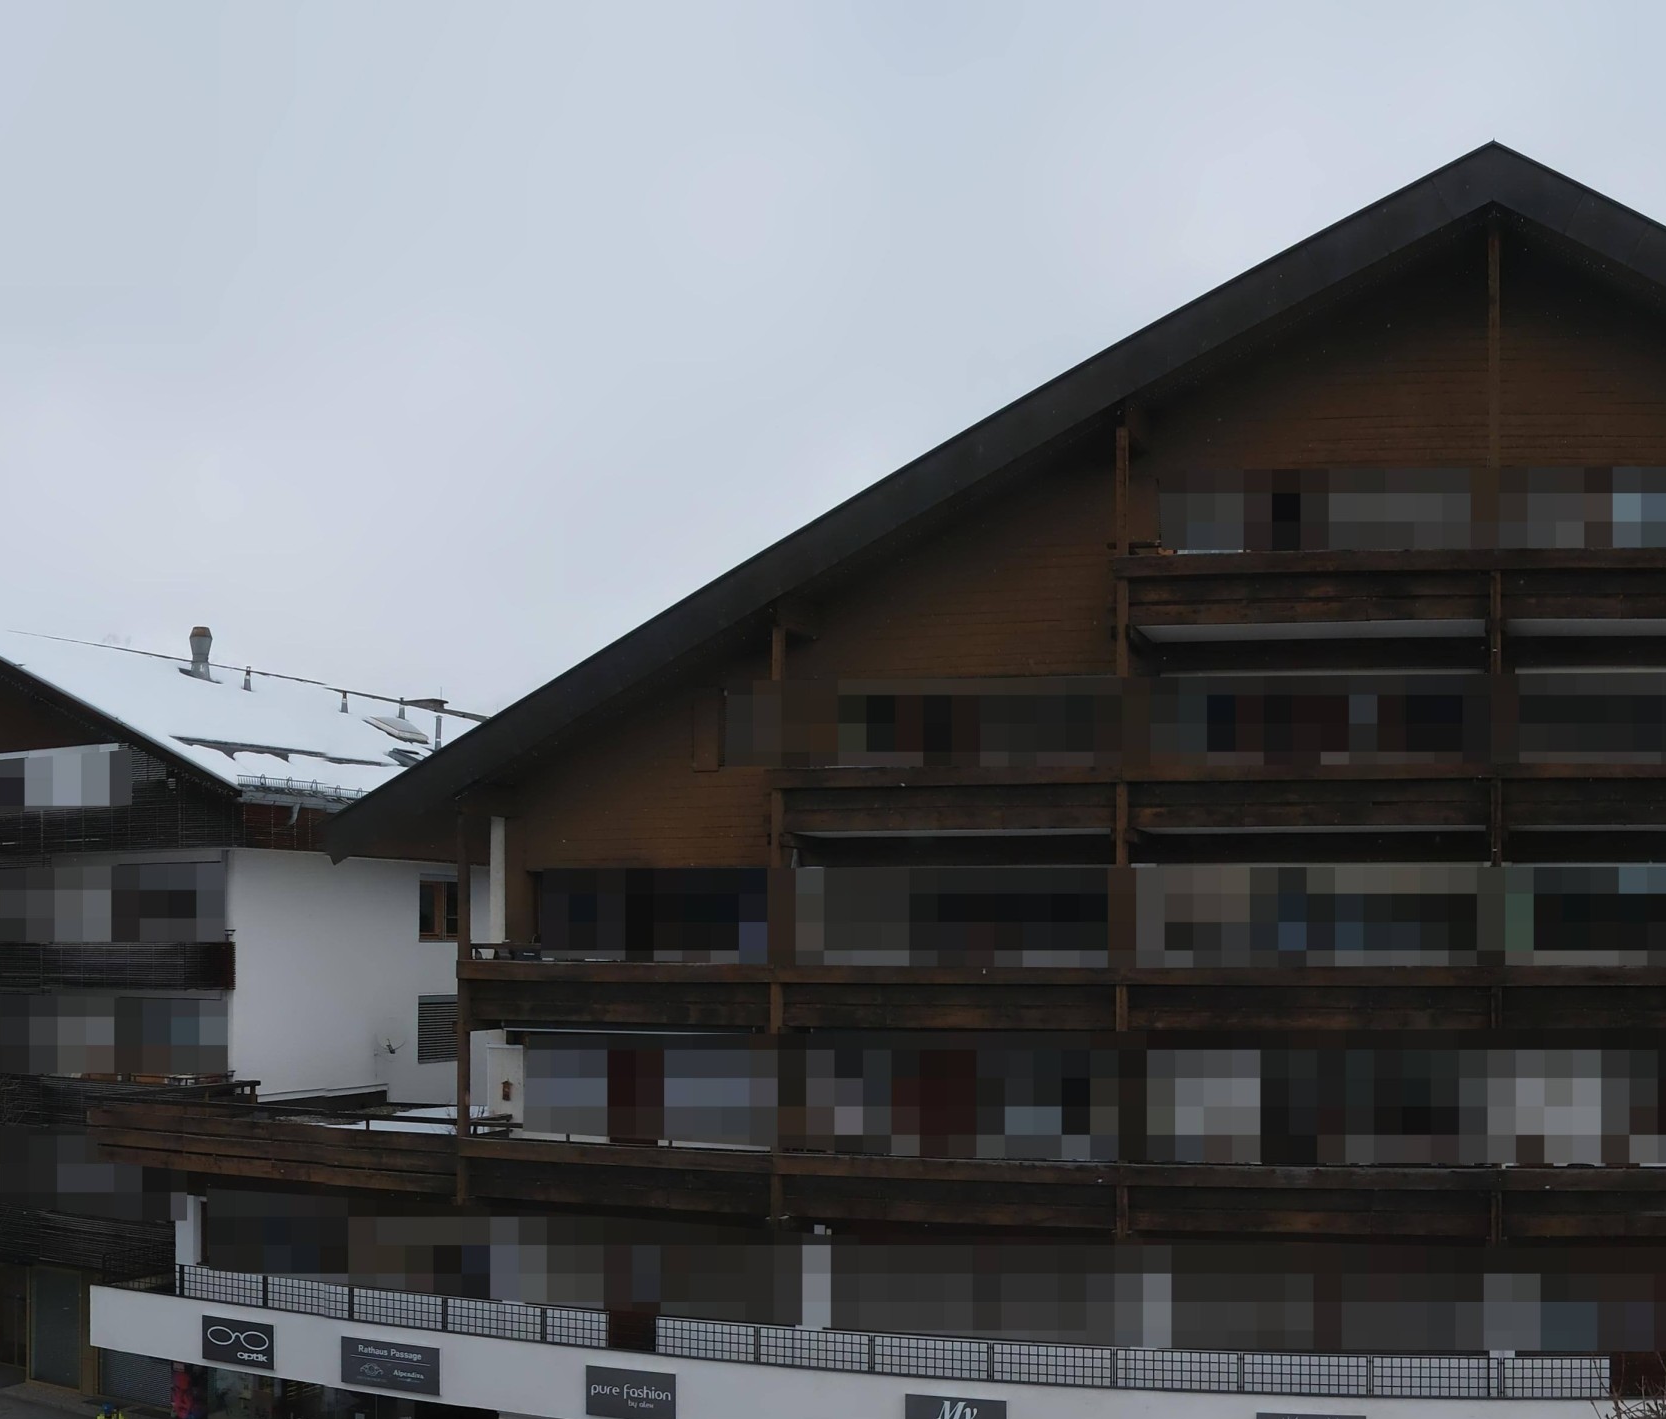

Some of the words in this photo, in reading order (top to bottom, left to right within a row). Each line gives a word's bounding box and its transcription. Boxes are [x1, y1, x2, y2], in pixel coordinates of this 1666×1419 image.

[236, 1351, 269, 1363] optik
[358, 1344, 388, 1356] Rathaus
[390, 1348, 422, 1362] Passage
[591, 1383, 620, 1397] pure
[623, 1382, 672, 1401] fashion
